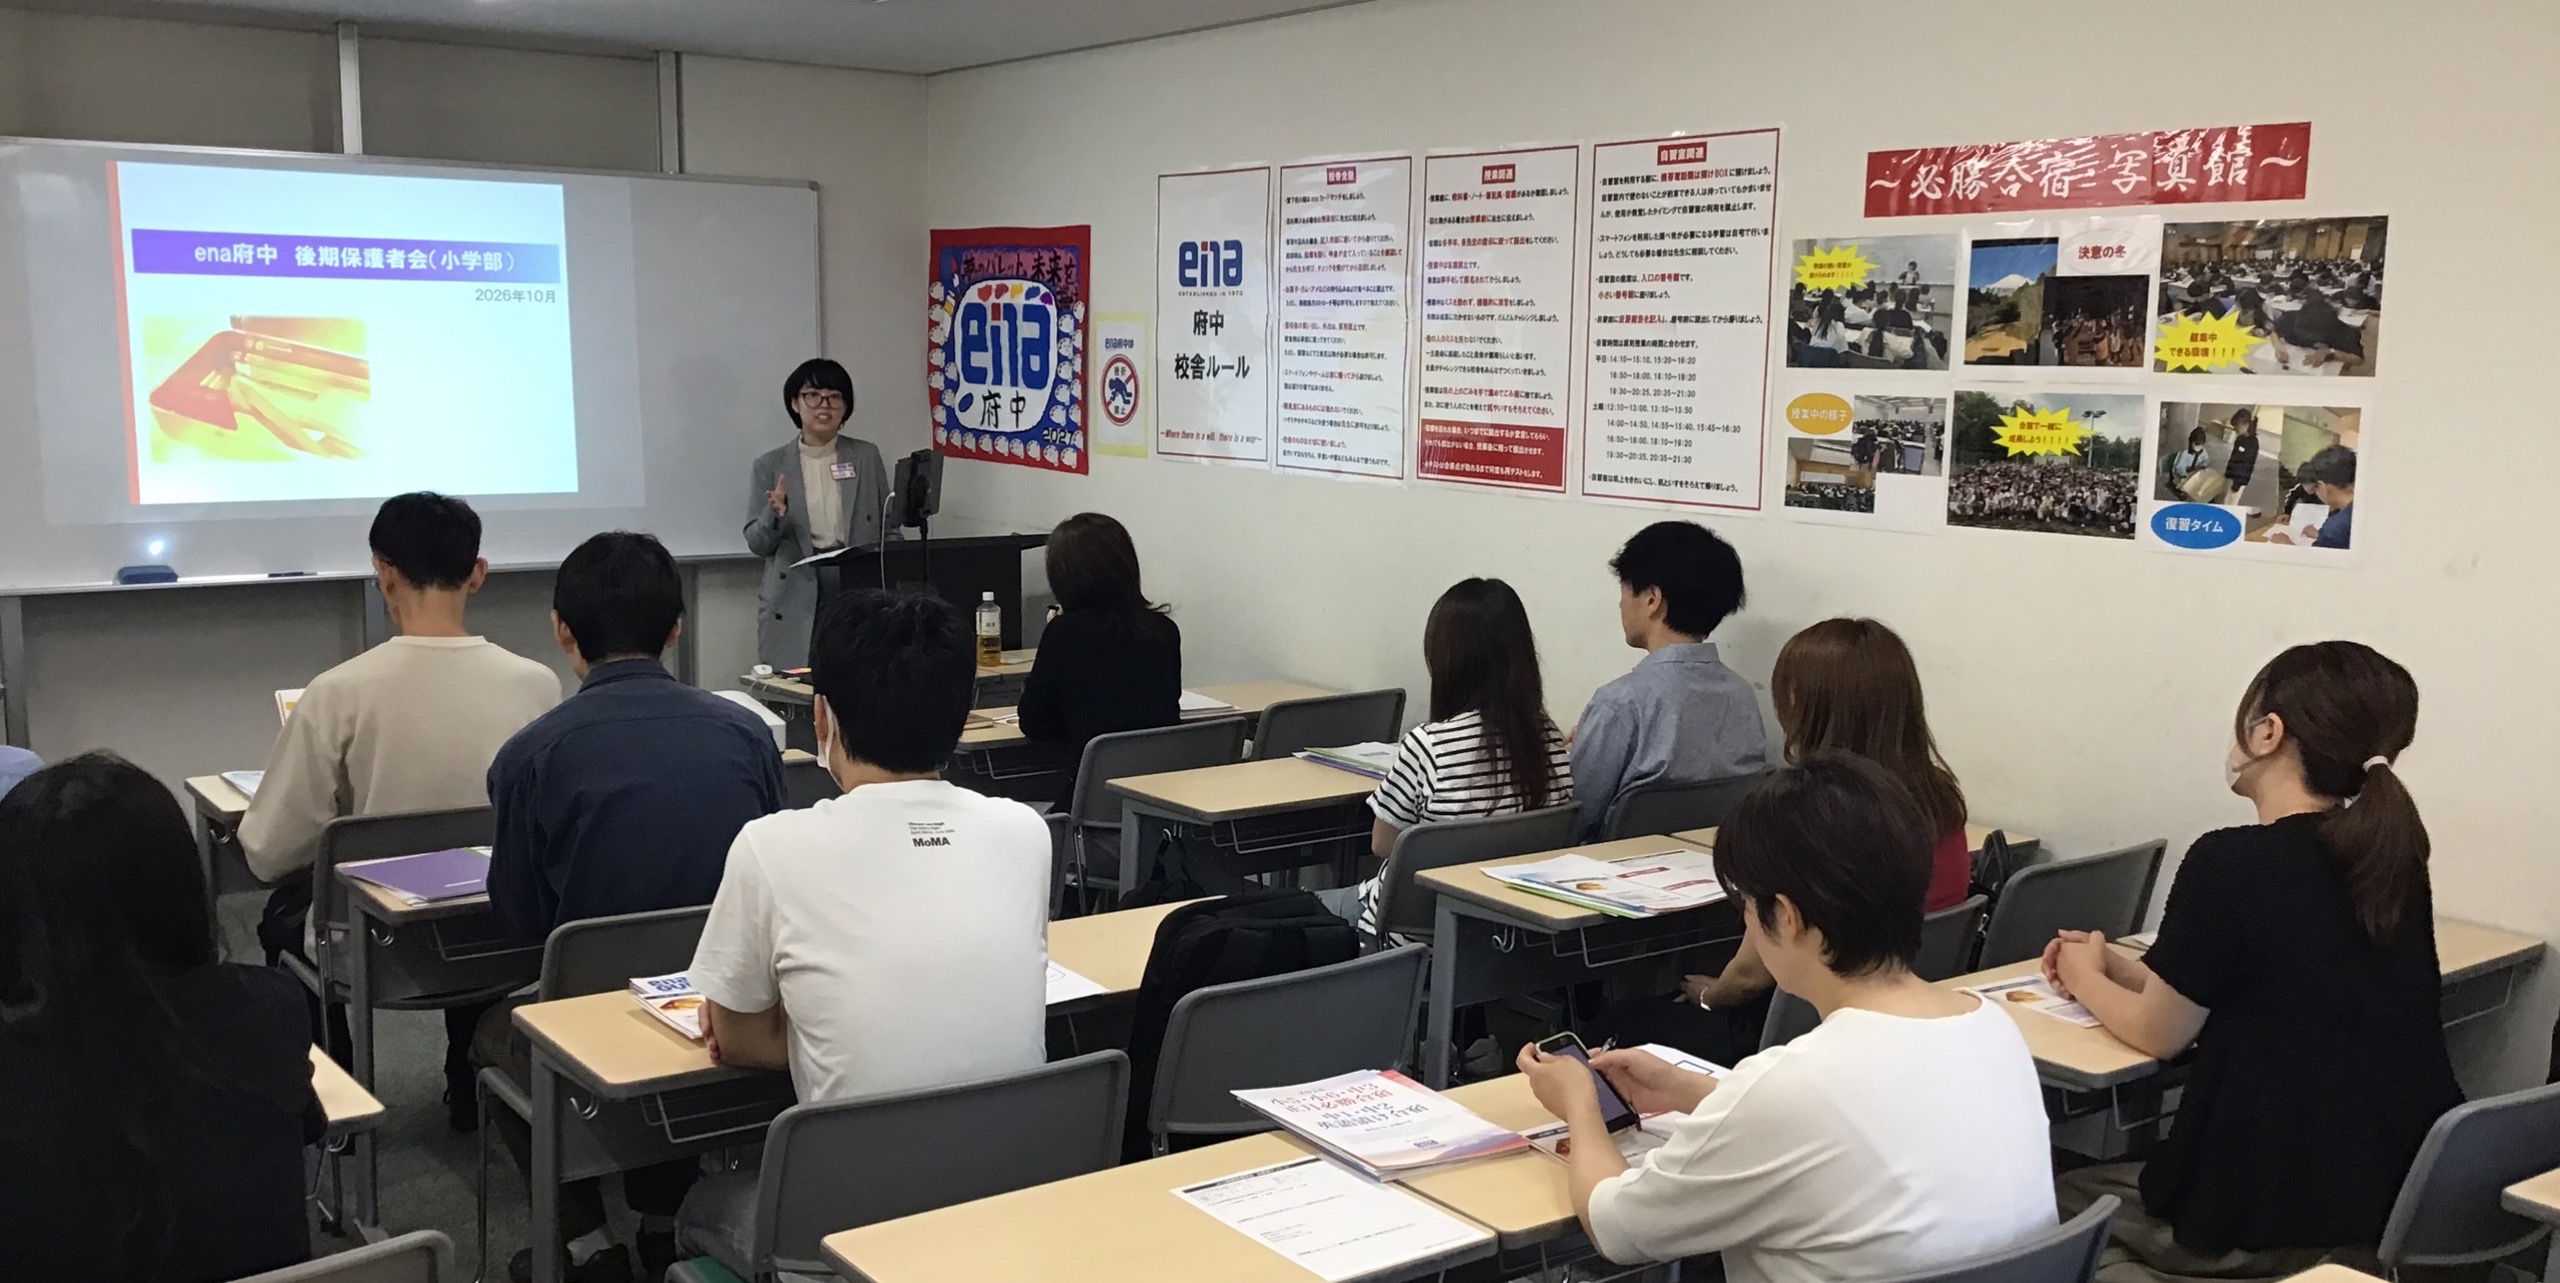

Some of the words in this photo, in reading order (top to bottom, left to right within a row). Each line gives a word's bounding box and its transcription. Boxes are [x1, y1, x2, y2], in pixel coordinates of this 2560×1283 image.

[195, 243, 278, 264] ena府中
[2078, 244, 2127, 260] 決意の冬
[1178, 239, 1243, 288] ena
[475, 287, 557, 304] 2026年10月
[1193, 309, 1225, 336] 府中
[1174, 353, 1250, 381] 校舎ルール
[980, 389, 1027, 429] 府中
[1043, 429, 1074, 446] 2027
[2165, 516, 2224, 532] 復習タイム
[912, 837, 951, 847] MoMA
